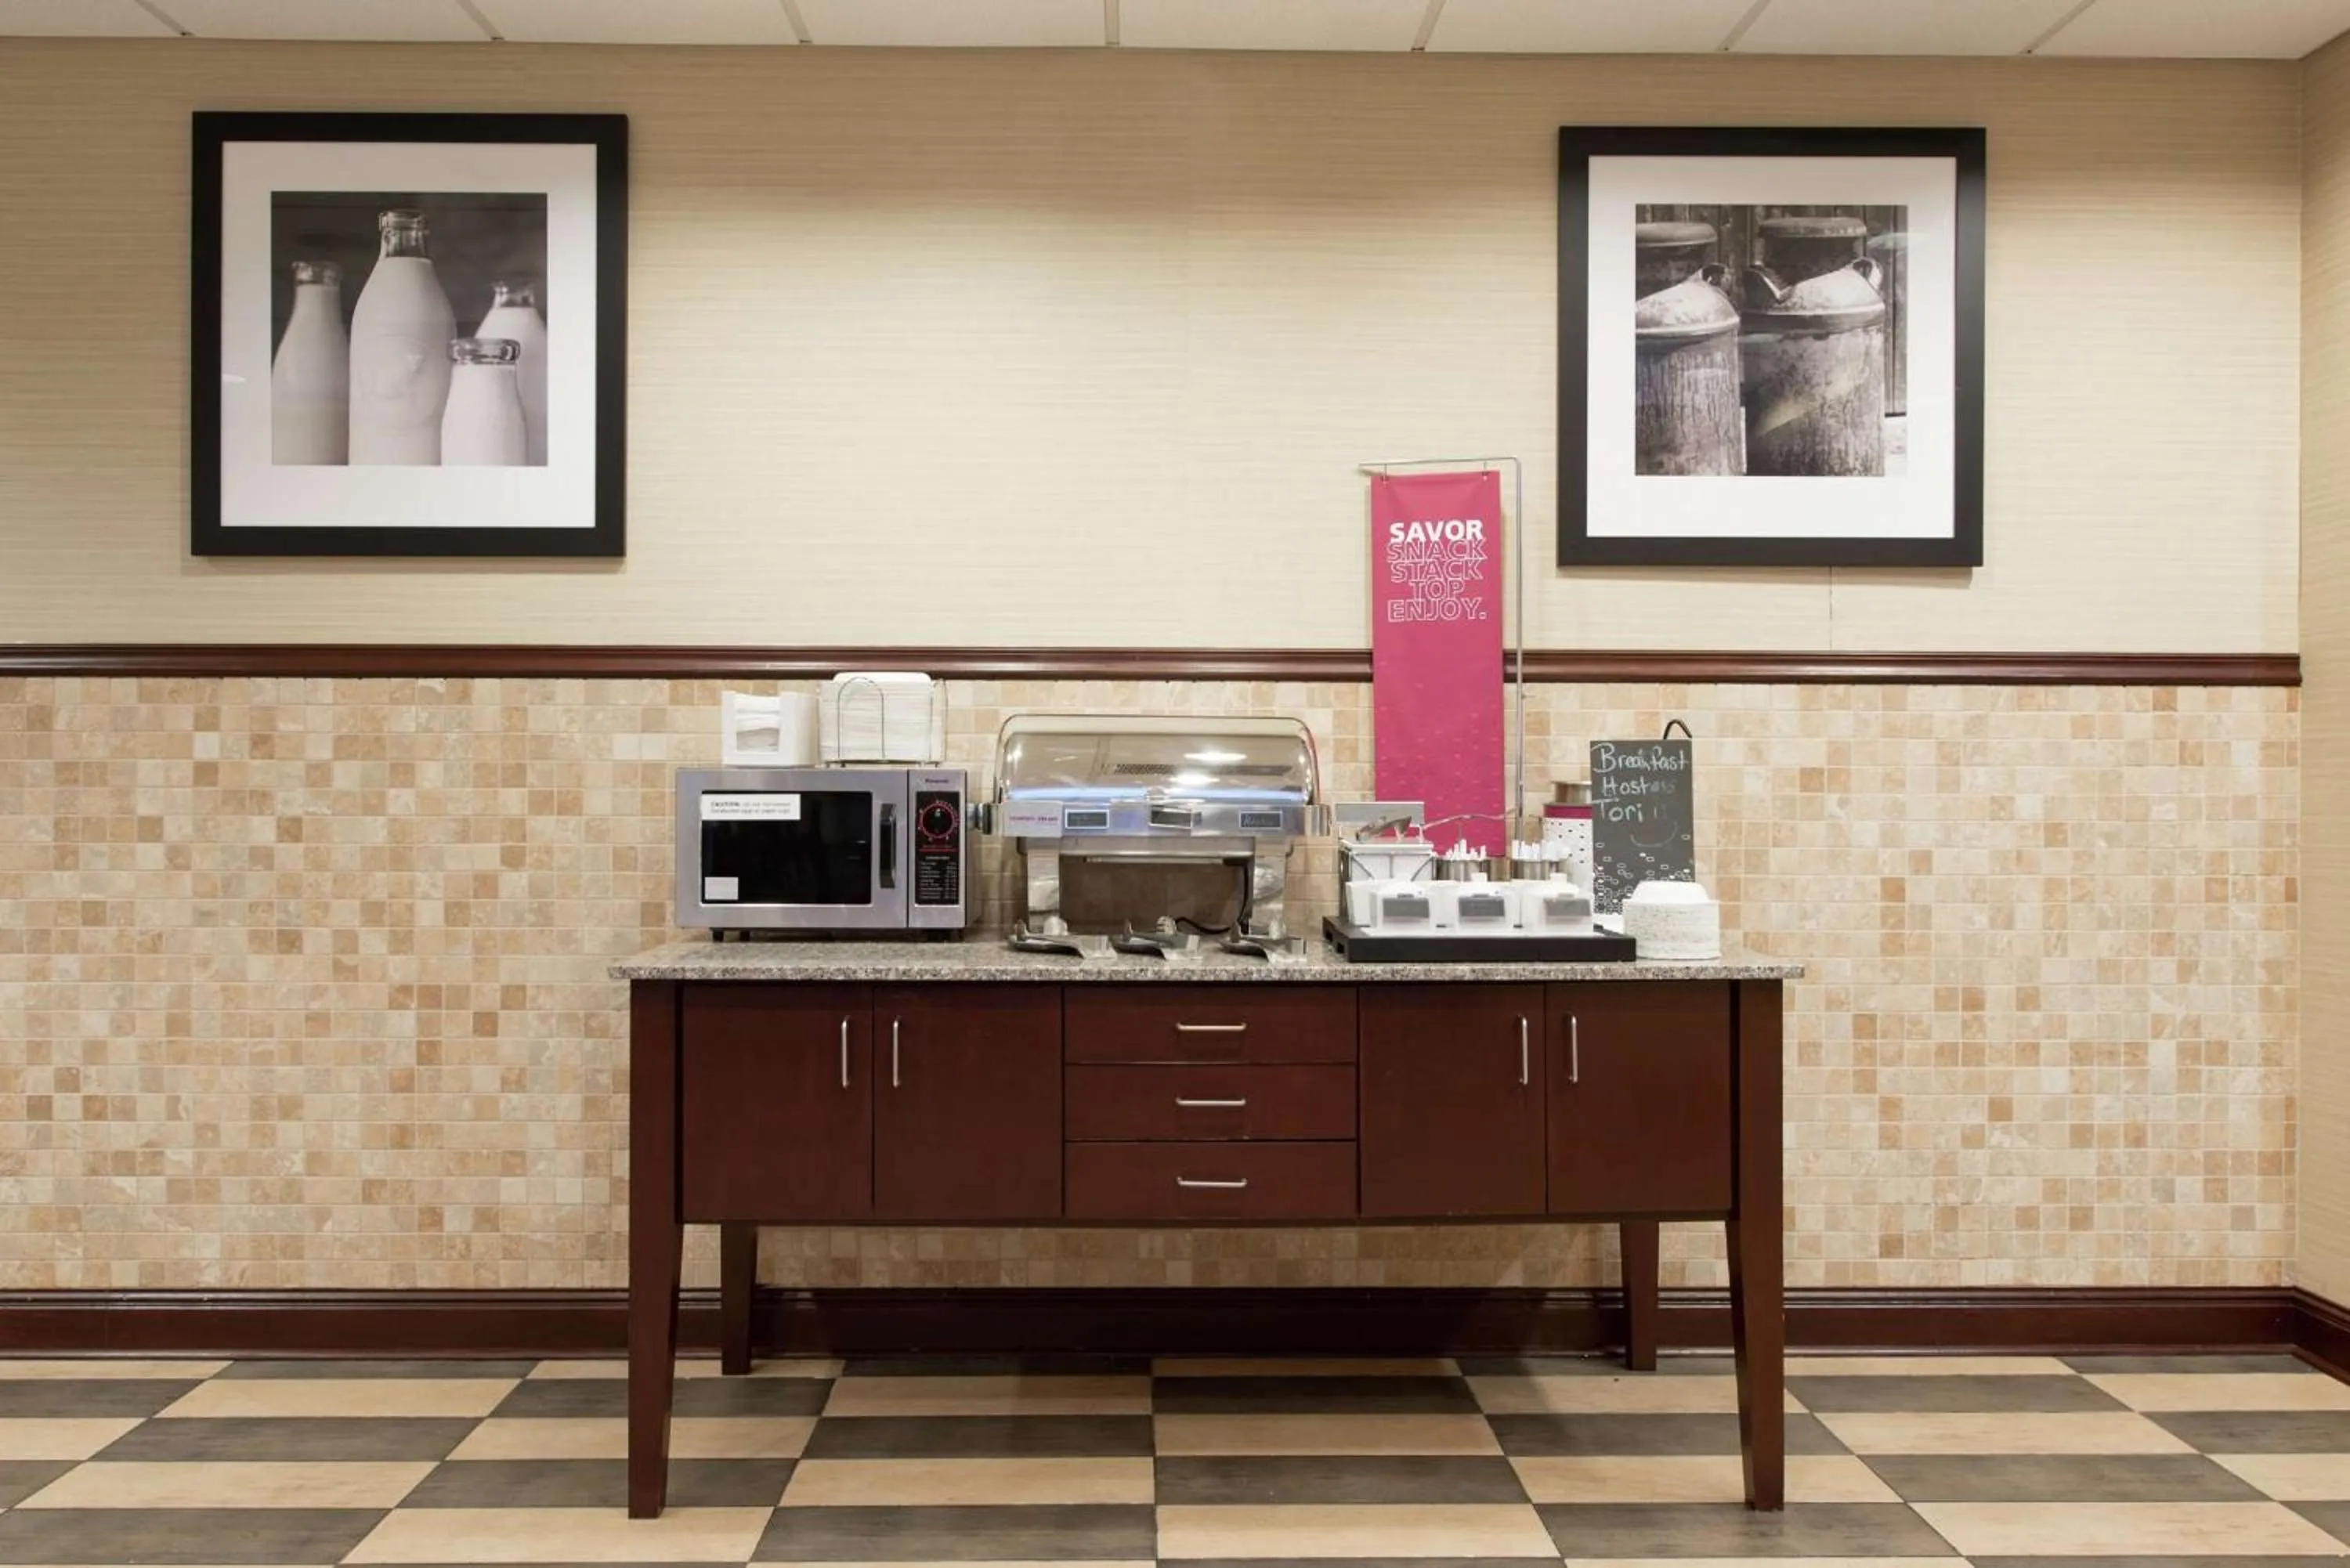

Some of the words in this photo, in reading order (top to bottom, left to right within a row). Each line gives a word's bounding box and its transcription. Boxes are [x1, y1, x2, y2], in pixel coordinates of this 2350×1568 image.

[1390, 520, 1483, 543] SAVOR
[1386, 538, 1487, 562] SNACK
[1390, 558, 1484, 582] STACK
[1408, 578, 1465, 601] TOP
[1387, 597, 1487, 622] ENJOY.
[1591, 797, 1643, 823] Tori
